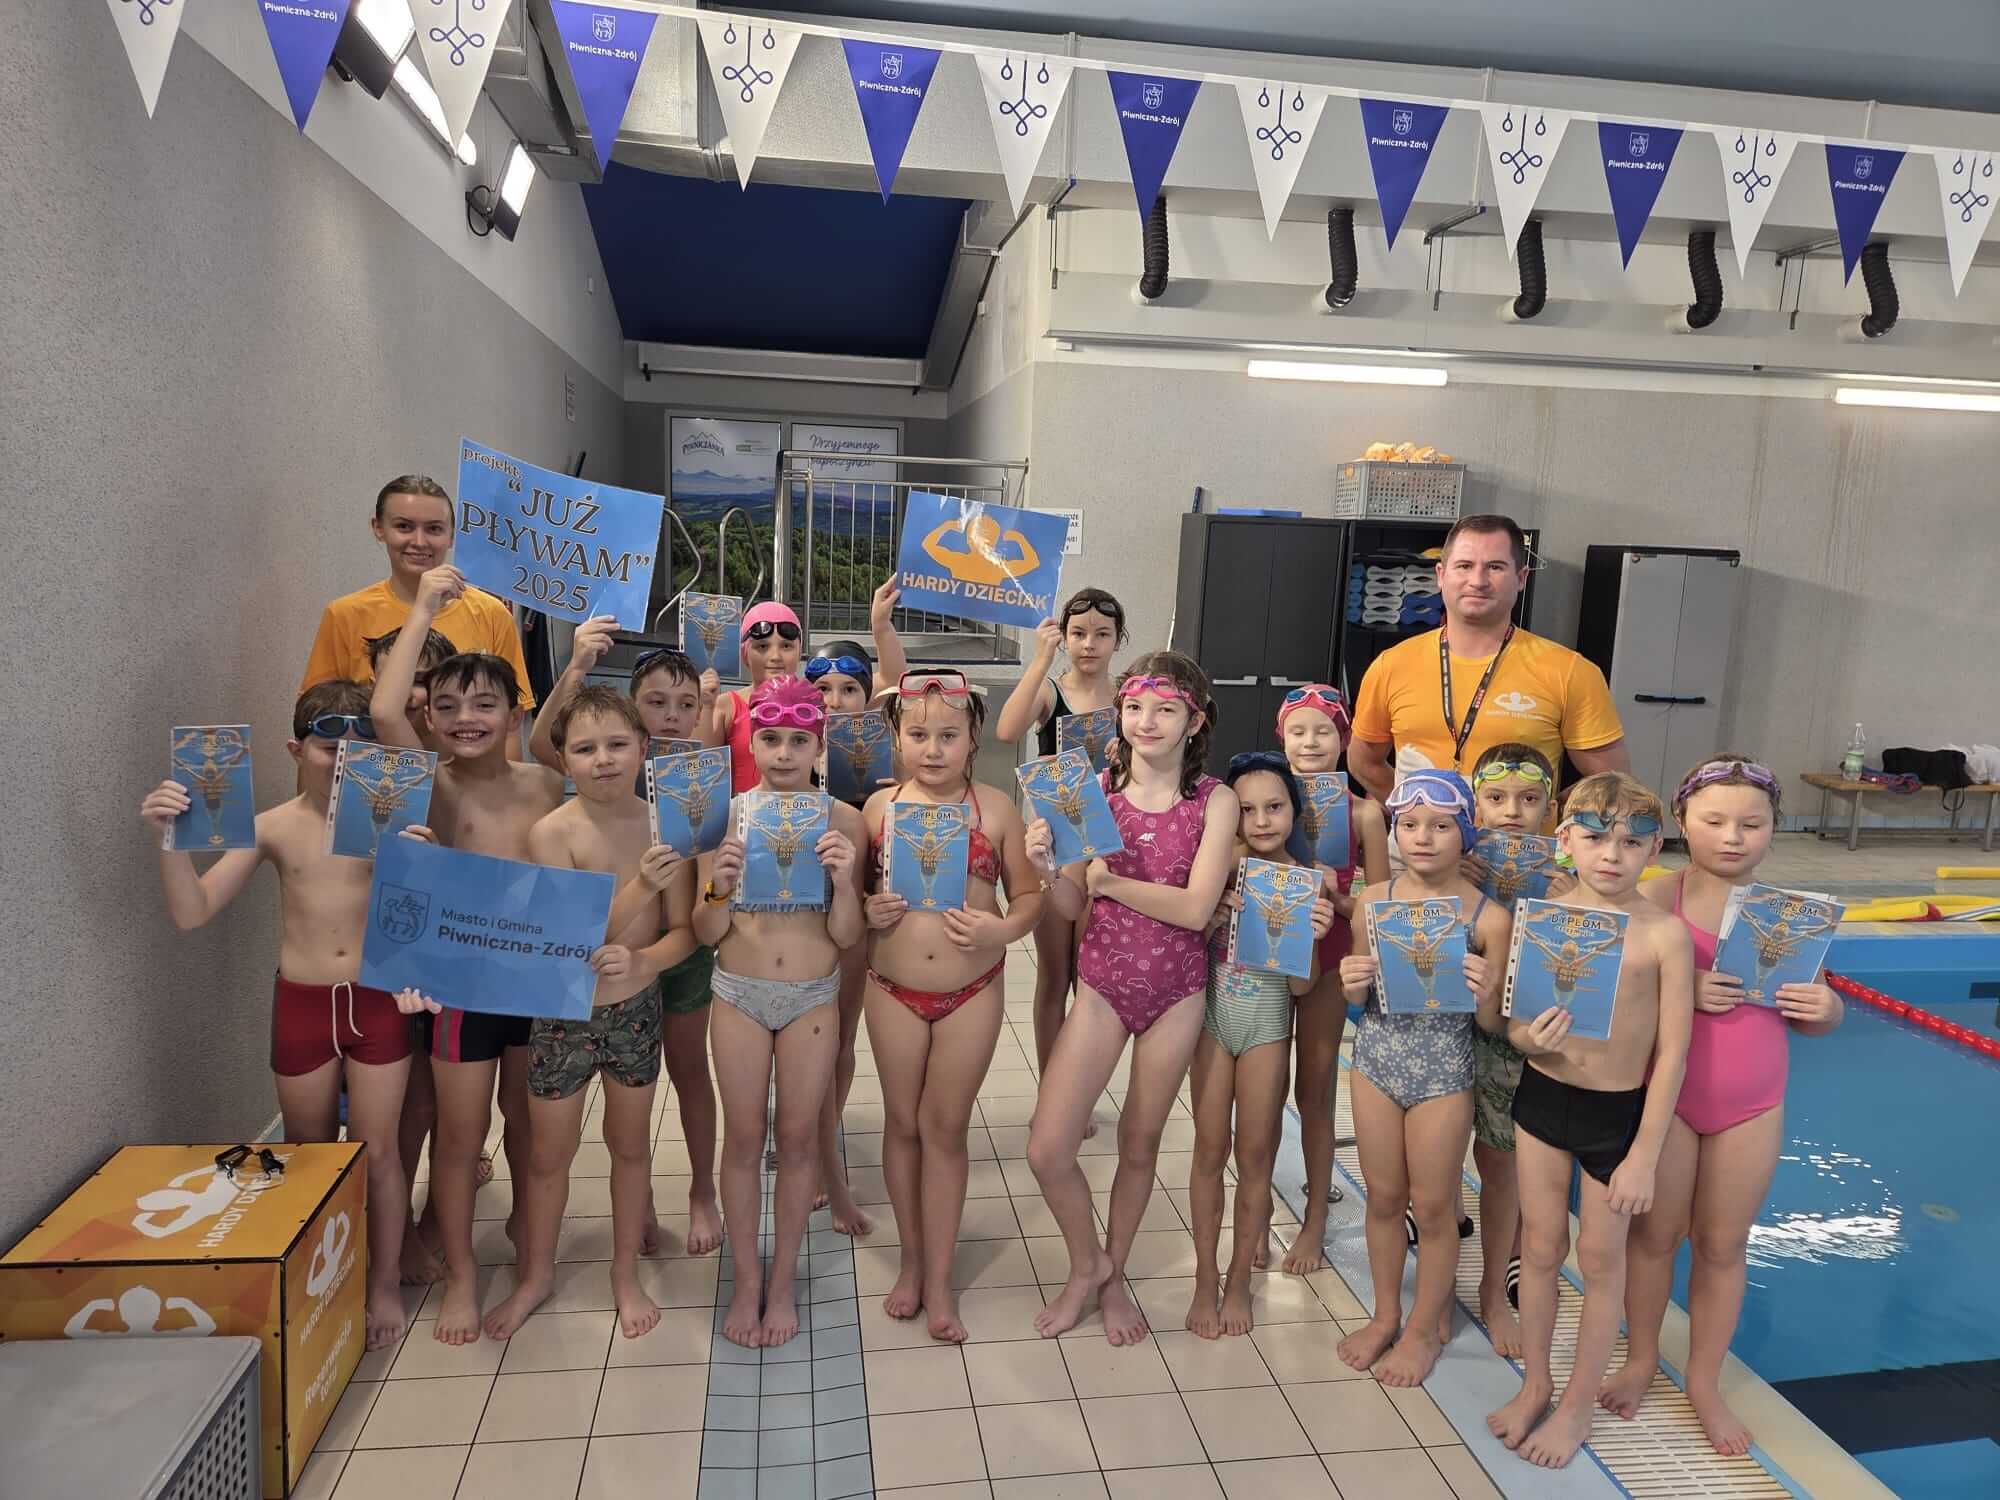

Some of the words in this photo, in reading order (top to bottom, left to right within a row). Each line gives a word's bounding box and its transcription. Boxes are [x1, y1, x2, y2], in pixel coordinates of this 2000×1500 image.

[265, 2, 337, 23] Piwniczna-Zdrój
[569, 41, 637, 62] Piwniczna-Zdrój
[859, 80, 921, 98] Piwniczna-Zdrój
[1122, 110, 1180, 127] Piwniczna-Zdrój
[1371, 137, 1429, 151] Piwniczna-Zdrój
[1608, 160, 1665, 172] Piwniczna-Zdrój
[809, 433, 880, 452] Przyjemnego
[512, 565, 590, 612] 2025
[902, 572, 961, 594] HARDY
[964, 583, 1048, 610] DZIECIAK
[369, 752, 415, 768] DYPLOM
[768, 800, 808, 809] DYPLOM
[912, 811, 951, 822] DYPLOM
[1264, 870, 1302, 884] DYPLOM
[1396, 909, 1440, 919] DYPLOM
[1769, 898, 1819, 917] DYPLOM
[441, 908, 487, 927] Miasto
[490, 918, 495, 928] i
[497, 919, 543, 935] Gmina
[1551, 914, 1601, 930] DYPLOM
[438, 925, 592, 963] Piwniczna-Zdrój
[196, 1207, 248, 1248] HARDY
[300, 1300, 324, 1345] HARDY
